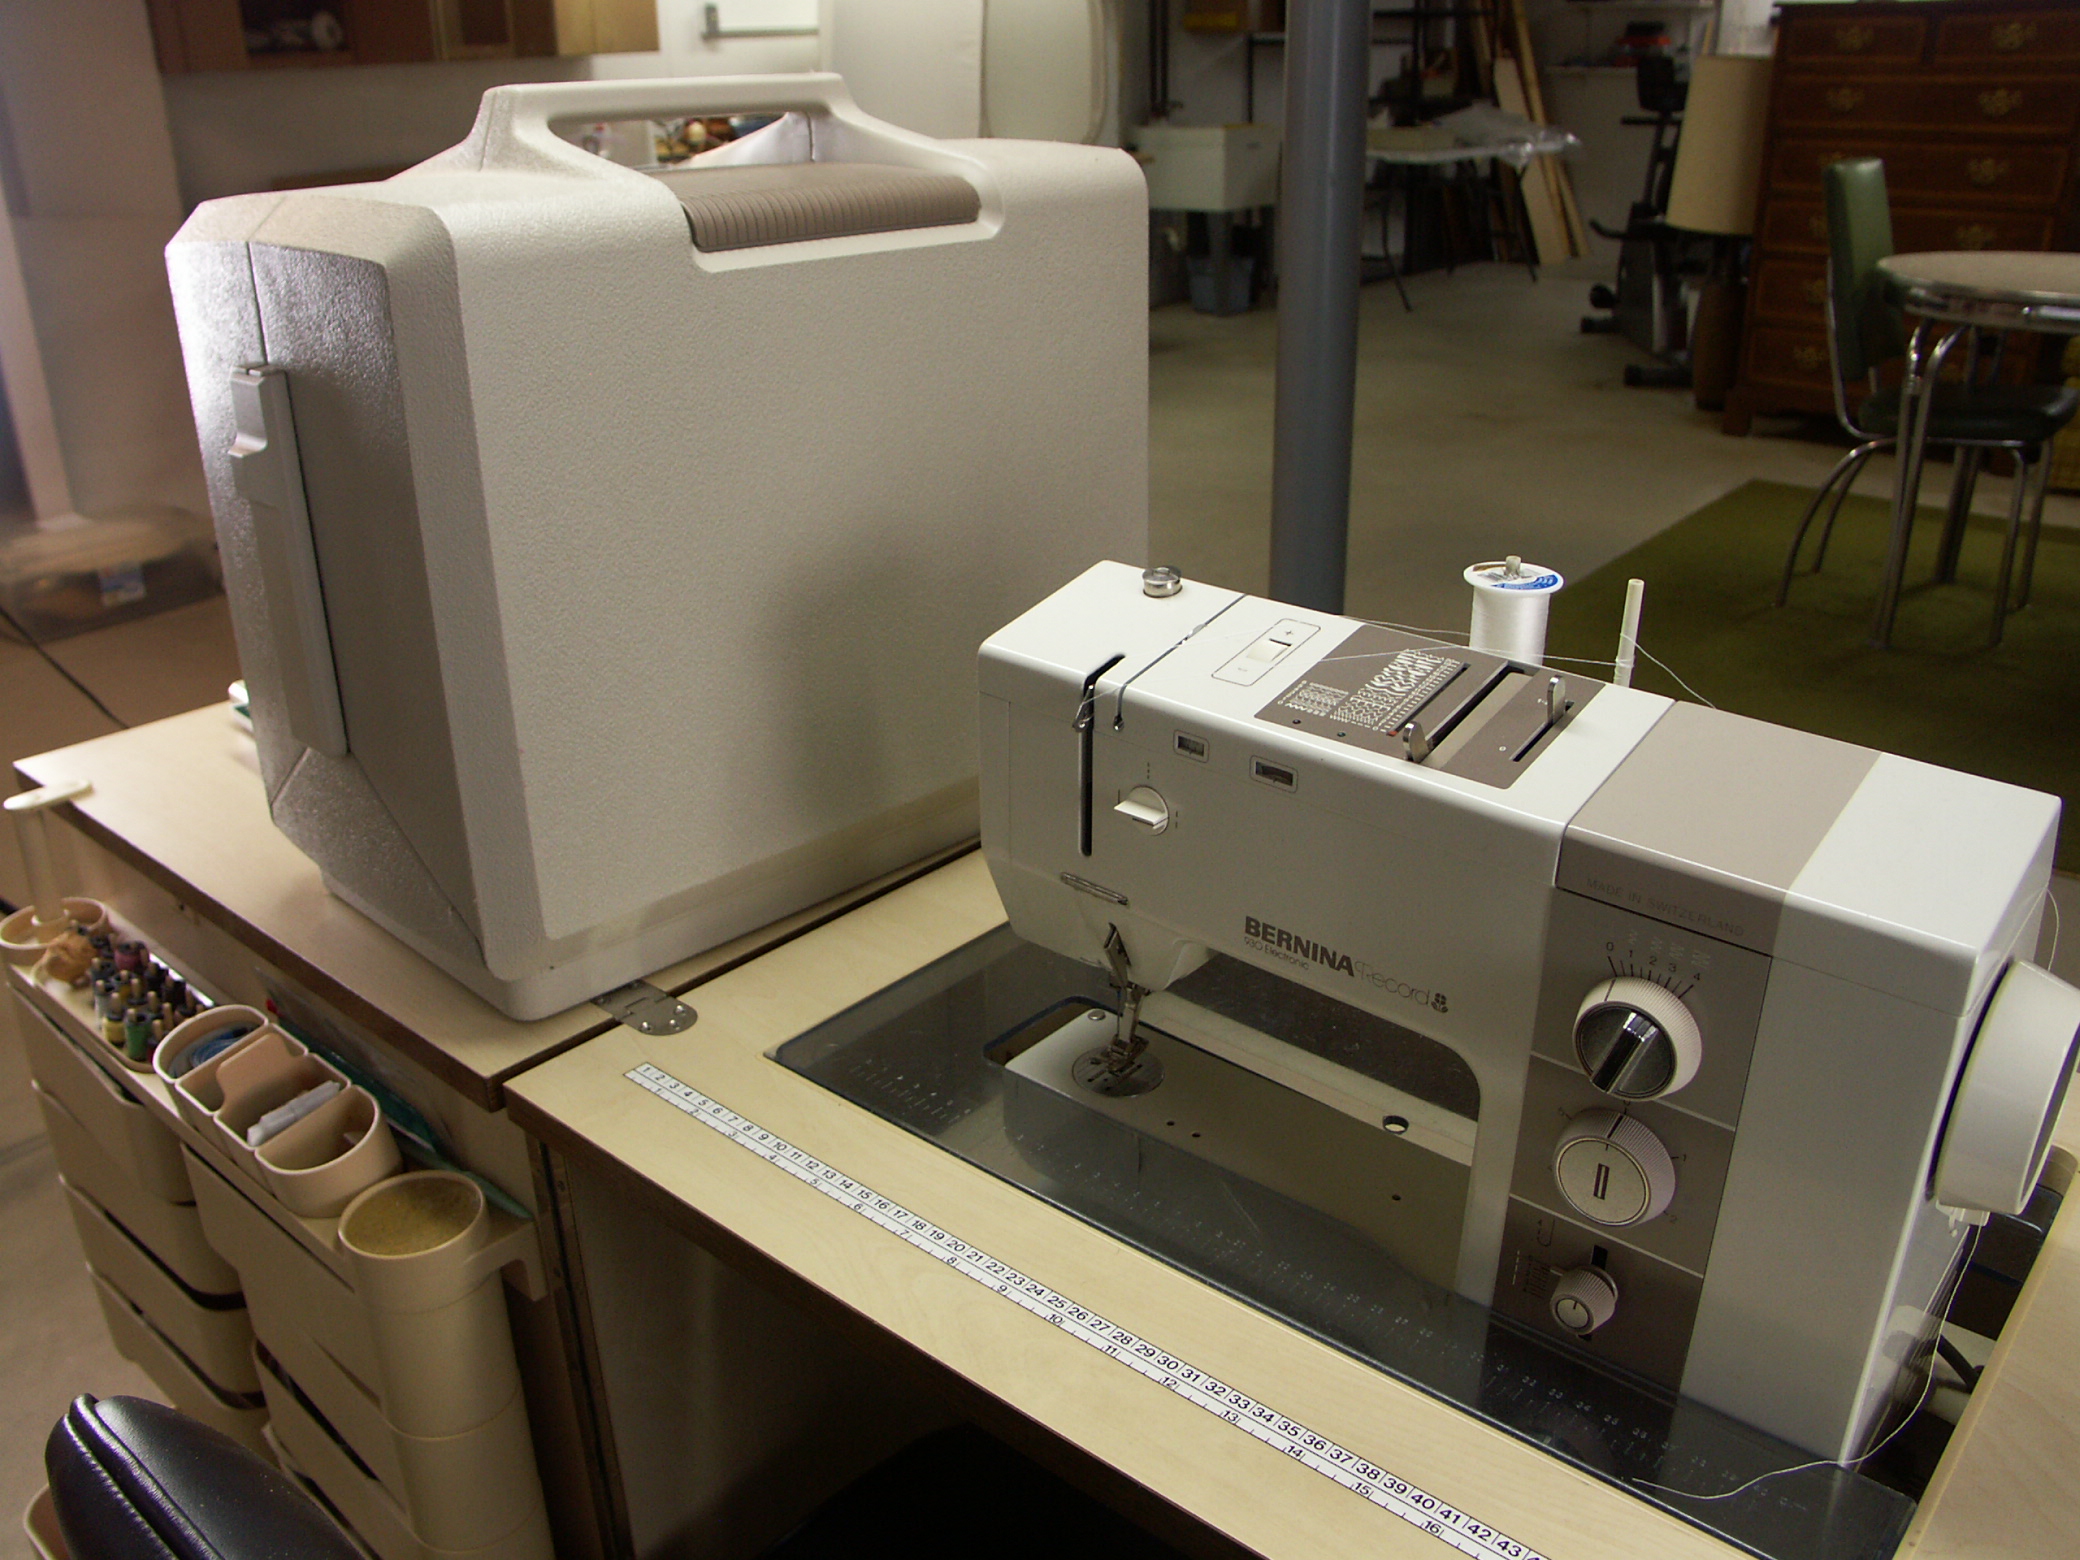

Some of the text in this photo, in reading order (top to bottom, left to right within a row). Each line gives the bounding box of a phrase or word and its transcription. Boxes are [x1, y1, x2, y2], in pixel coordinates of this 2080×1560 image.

[1586, 879, 1745, 936] MADE IN SWITZERLAND
[1244, 936, 1310, 971] 930 Electronic
[1245, 916, 1431, 1007] BERNINA Record
[1606, 942, 1614, 952] 0
[1649, 956, 1657, 966] 2
[1669, 964, 1677, 973] 3
[1694, 973, 1701, 981] 4
[773, 1141, 787, 1151] 10
[790, 1151, 802, 1160] 11
[805, 1160, 820, 1170] 12
[822, 1169, 837, 1180] 13
[839, 1179, 853, 1190] 14
[857, 1189, 872, 1199] 15
[874, 1199, 890, 1210] 16
[893, 1209, 908, 1219] 17
[911, 1220, 927, 1231] 18
[929, 1230, 945, 1241] 19
[946, 1239, 966, 1252] 20
[966, 1251, 983, 1262] 21
[986, 1261, 1005, 1274] 22
[1005, 1272, 1026, 1286] 23
[1025, 1283, 1045, 1296] 24
[1047, 1295, 1067, 1309] 25
[1068, 1306, 1089, 1321] 26
[1090, 1319, 1111, 1331] 27
[1112, 1331, 1133, 1346] 28
[1135, 1344, 1156, 1358] 29
[1157, 1355, 1179, 1370] 30
[1181, 1369, 1201, 1382] 31
[1205, 1381, 1226, 1396] 32
[1229, 1394, 1251, 1410] 33
[1252, 1407, 1275, 1423] 34
[1277, 1420, 1302, 1437] 35
[1303, 1434, 1327, 1451] 36
[1329, 1449, 1354, 1463] 37
[1356, 1463, 1381, 1480] 38
[1383, 1478, 1408, 1494] 39
[1411, 1494, 1435, 1510] 40
[1439, 1509, 1461, 1524] 41
[1467, 1524, 1492, 1542] 42
[1497, 1540, 1522, 1557] 43
[853, 1203, 863, 1211] 6
[946, 1256, 958, 1265] 8
[997, 1284, 1008, 1294] 9
[1049, 1313, 1063, 1324] 10
[1105, 1345, 1118, 1355] 11
[1161, 1377, 1177, 1387] 12
[1222, 1410, 1239, 1422] 13
[1287, 1446, 1303, 1457] 14
[1355, 1482, 1371, 1495] 15
[1425, 1521, 1442, 1534] 16
